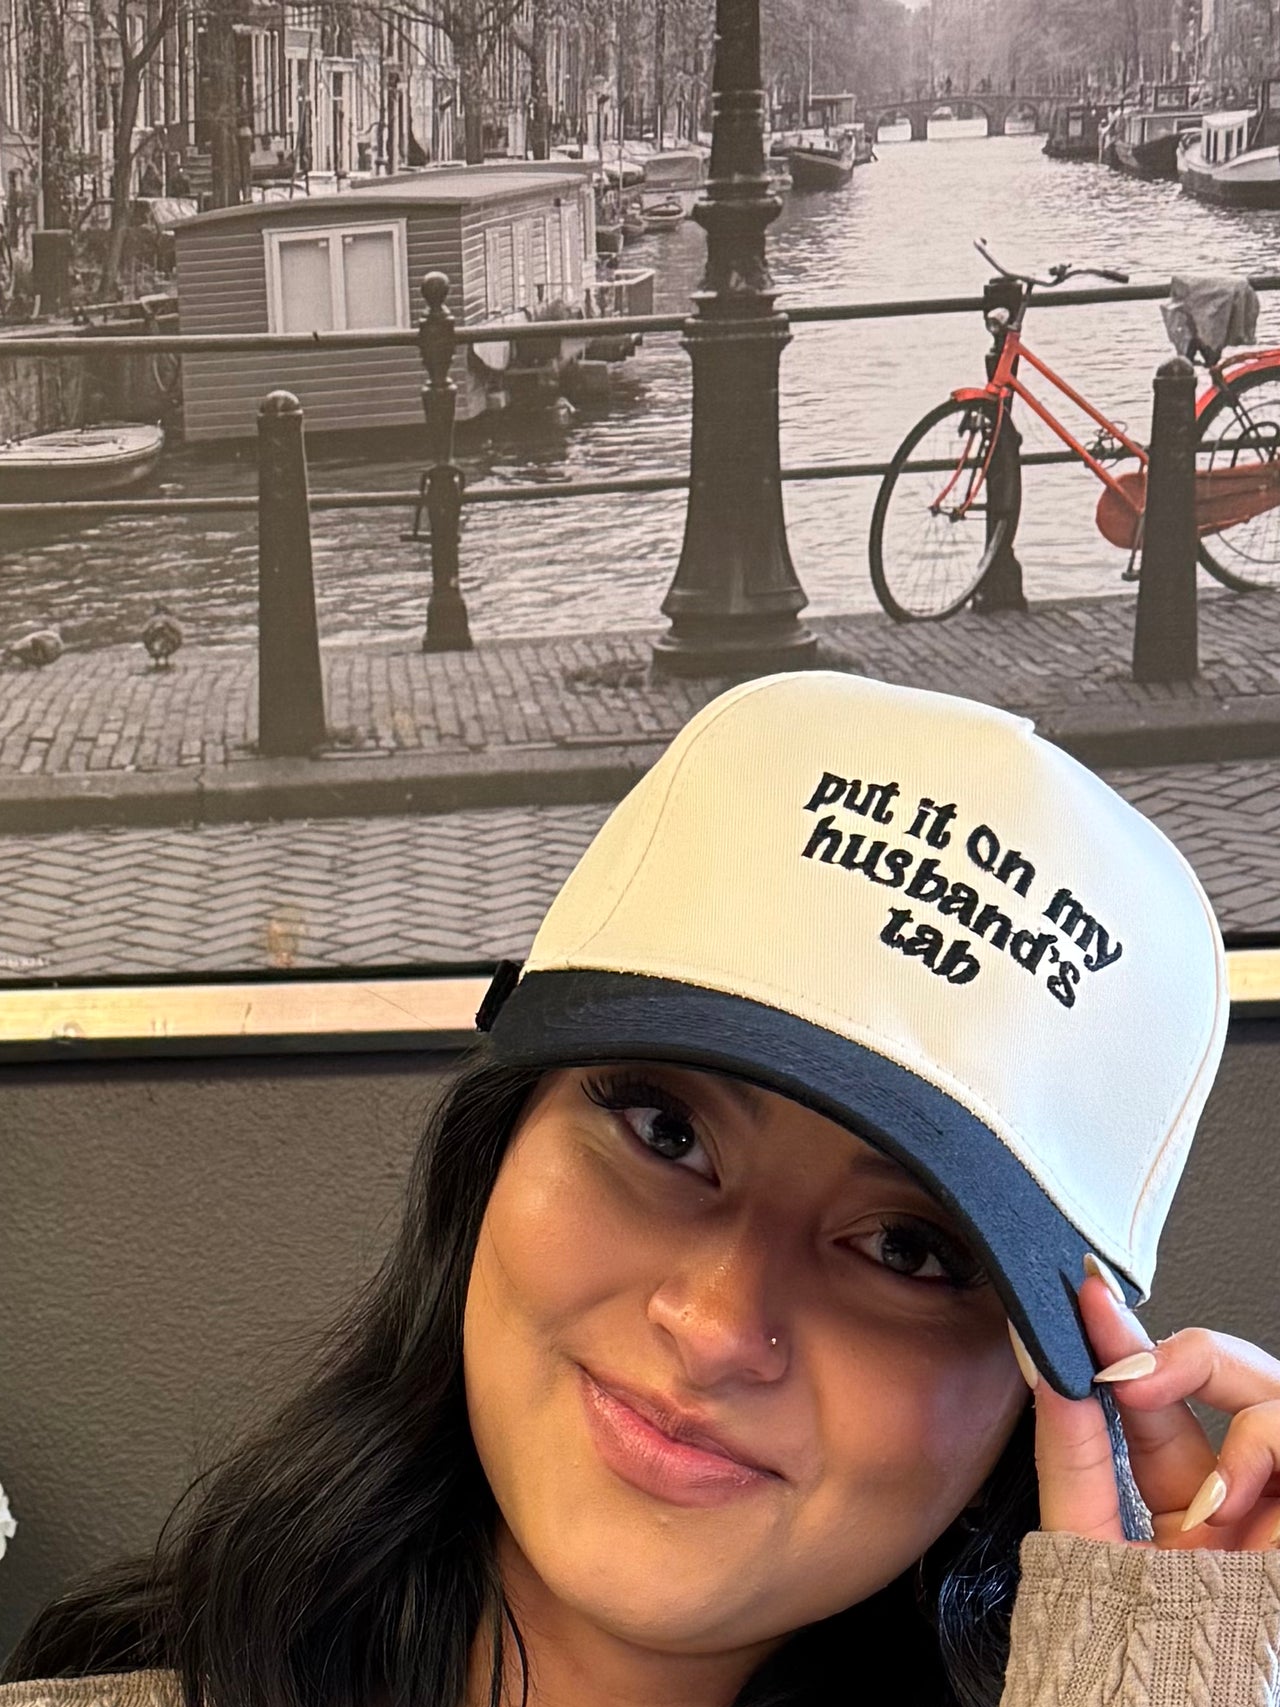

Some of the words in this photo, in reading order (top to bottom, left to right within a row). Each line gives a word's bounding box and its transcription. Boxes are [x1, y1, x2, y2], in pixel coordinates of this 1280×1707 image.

[801, 815, 1080, 1008] husband's
[803, 771, 900, 825] put
[904, 797, 958, 849] it
[1042, 888, 1122, 972] my
[877, 906, 981, 985] tab
